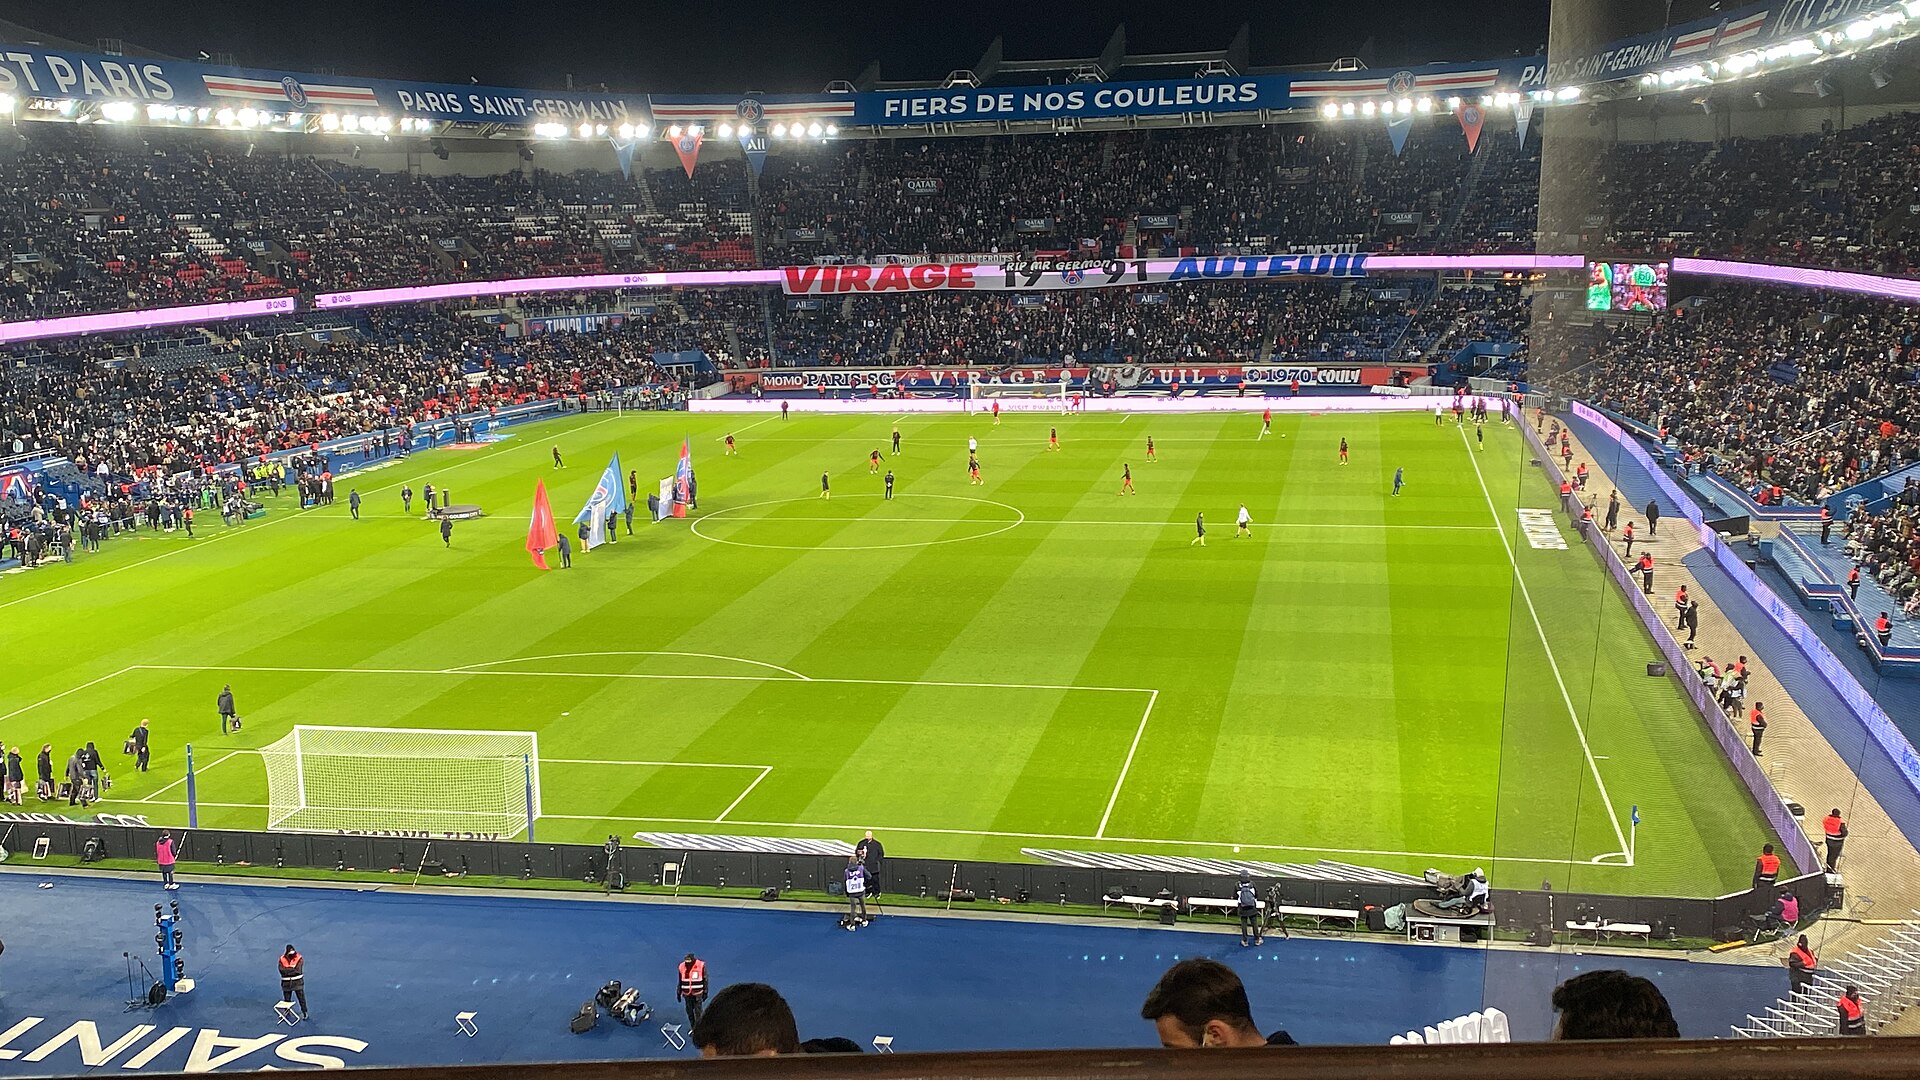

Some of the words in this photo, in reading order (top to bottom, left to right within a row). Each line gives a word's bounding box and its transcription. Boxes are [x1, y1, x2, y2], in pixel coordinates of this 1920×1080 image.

[1518, 58, 1571, 87] PARIS
[1571, 37, 1673, 79] SAINT-GERMAIN
[45, 54, 176, 101] PARIS
[397, 90, 463, 113] PARIS
[468, 94, 629, 121] SAINT-GERMAIN
[884, 95, 967, 118] FIERS
[976, 93, 1014, 113] DE
[1023, 91, 1086, 113] NOS
[1093, 82, 1259, 110] COULEURS
[907, 180, 937, 190] QATAR
[785, 263, 978, 293] VIRAGE
[1102, 260, 1148, 284] 91
[1168, 253, 1370, 280] AUTEUIL
[1006, 261, 1026, 272] RIP
[1030, 260, 1050, 270] MR
[272, 300, 287, 309] QNB
[338, 294, 352, 303] QNB
[763, 375, 803, 387] MOMO
[806, 373, 861, 386] PARIS
[867, 372, 892, 386] SG
[1265, 368, 1313, 383] 1970
[1317, 368, 1361, 384] COULY
